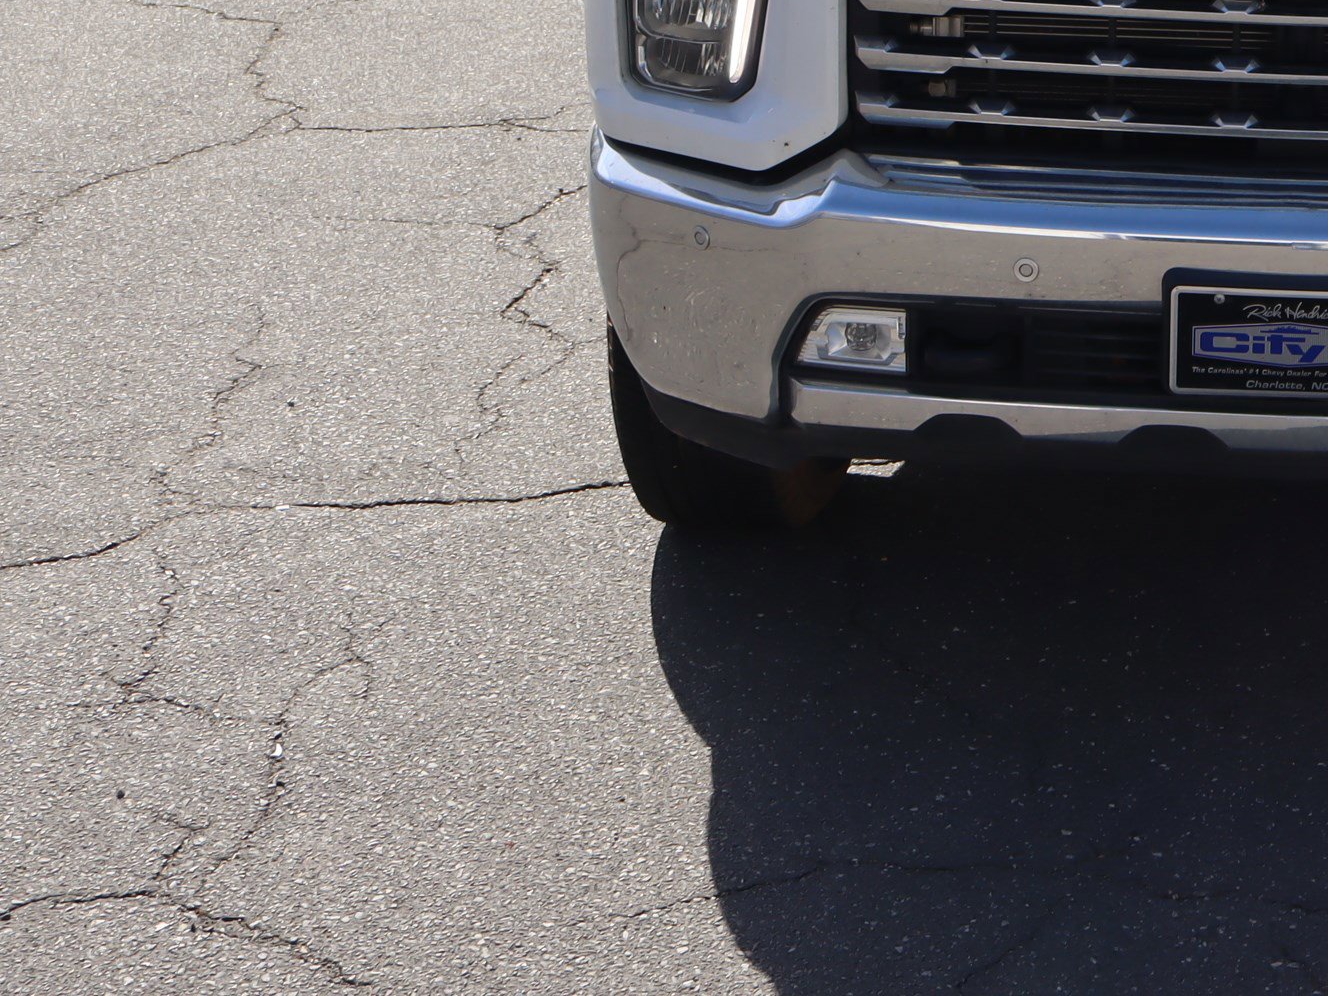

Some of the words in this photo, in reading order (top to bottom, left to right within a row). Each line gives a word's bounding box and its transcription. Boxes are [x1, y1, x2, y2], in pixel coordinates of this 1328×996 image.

[1242, 303, 1282, 322] Rick
[1200, 332, 1326, 363] City
[1261, 369, 1284, 377] Chevy
[1246, 380, 1306, 391] Charlotte,
